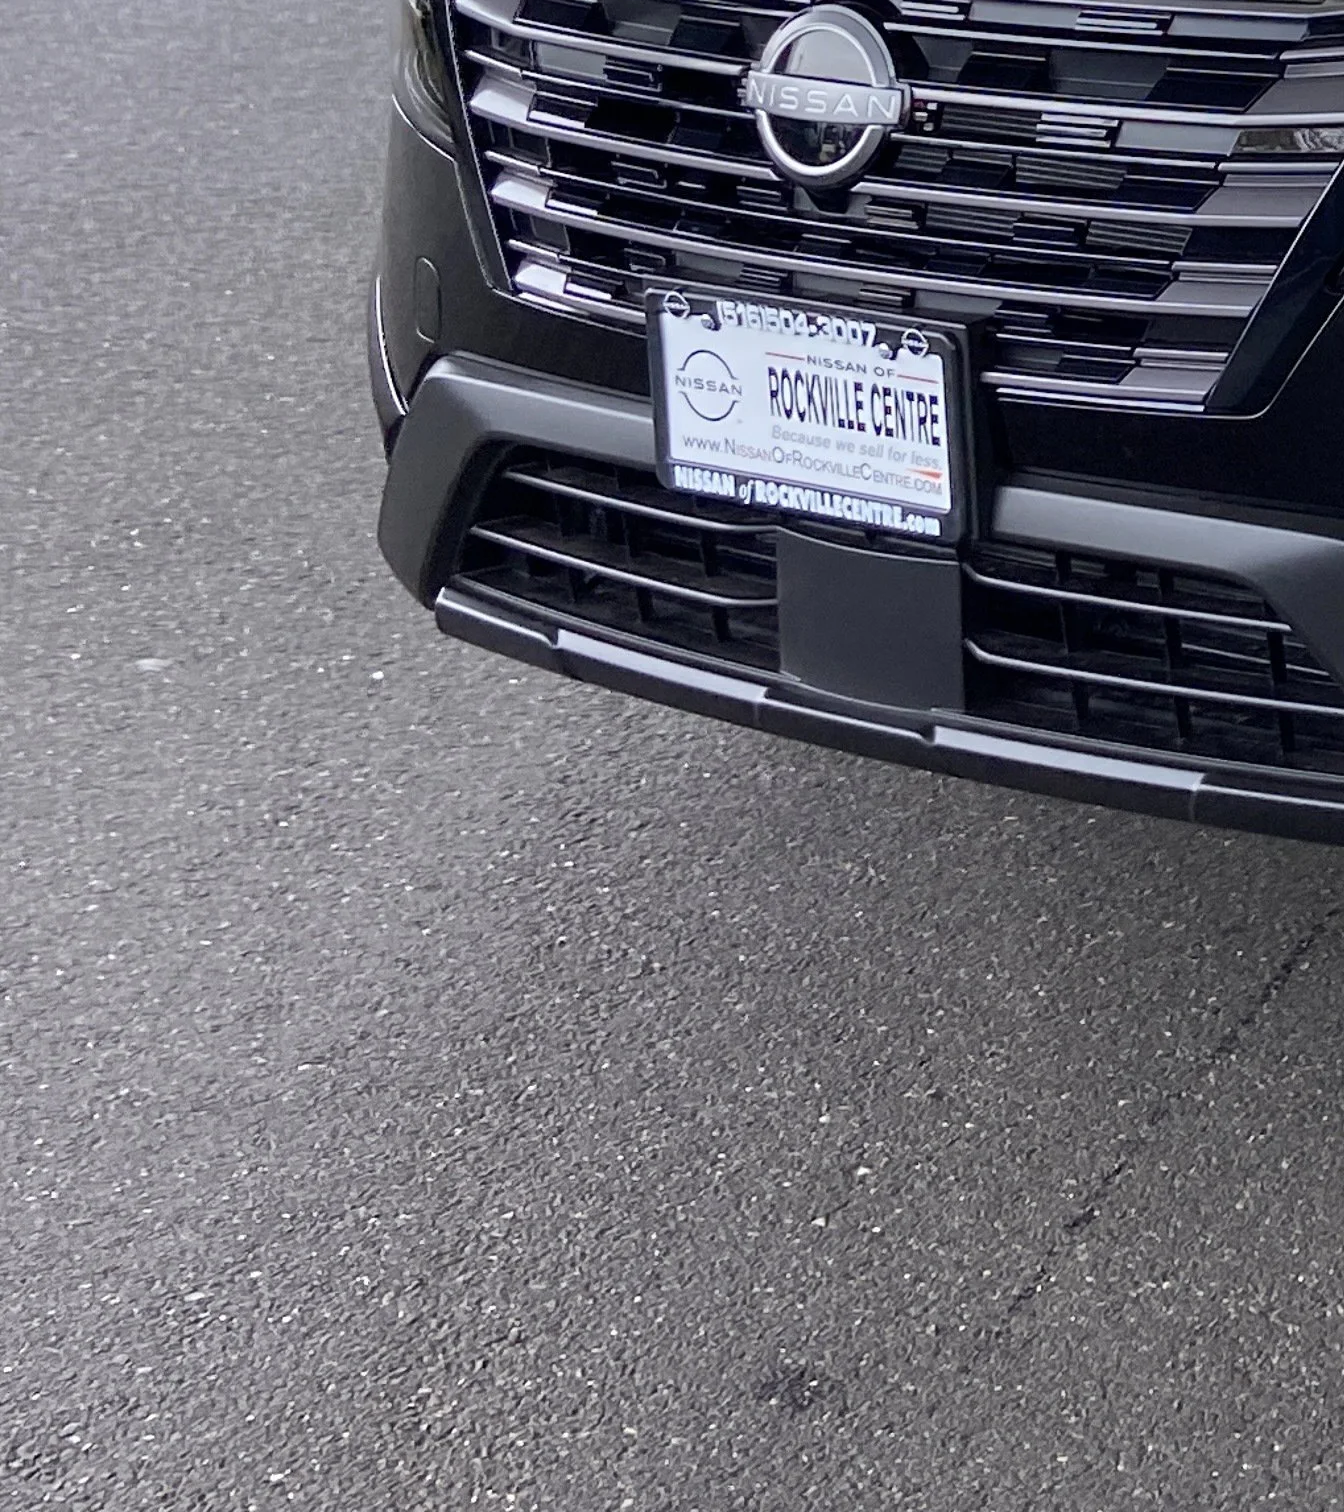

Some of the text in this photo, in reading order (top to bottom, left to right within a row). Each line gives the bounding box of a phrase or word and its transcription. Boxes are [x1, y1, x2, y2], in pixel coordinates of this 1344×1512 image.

[748, 78, 896, 120] NISSAN
[807, 354, 897, 379] NISSAN OF
[675, 374, 743, 397] NISSAN
[767, 366, 942, 447] ROCKVILLE CENTRE
[771, 424, 832, 450] Because
[835, 439, 856, 454] we
[858, 441, 885, 459] sell
[887, 445, 908, 463] for
[674, 465, 736, 498] NISSAN
